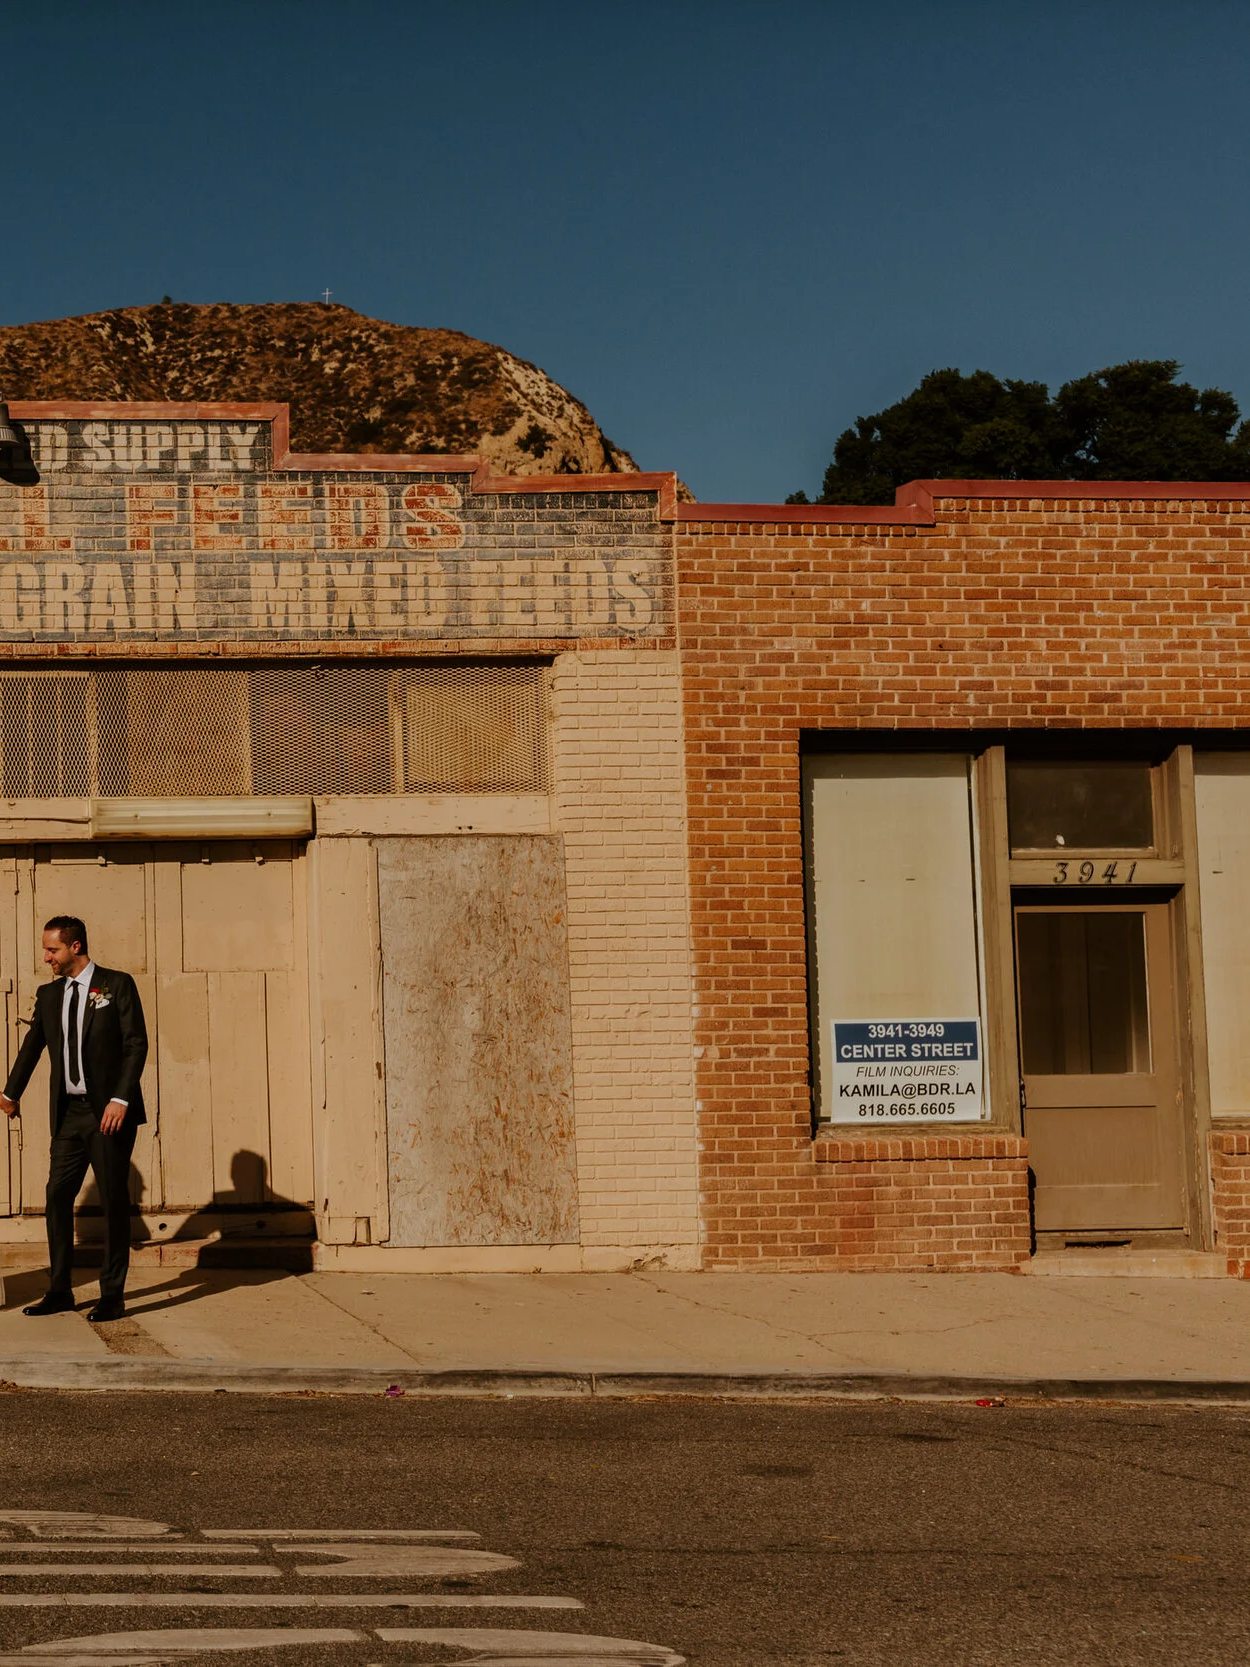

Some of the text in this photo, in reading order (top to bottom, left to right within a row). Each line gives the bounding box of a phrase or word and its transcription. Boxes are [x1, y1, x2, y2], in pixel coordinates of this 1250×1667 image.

[82, 421, 262, 470] SUPPLY
[124, 482, 466, 551] FEEDS
[1, 560, 197, 632] GRAIN
[249, 560, 447, 631] MIXED
[1052, 860, 1139, 884] 3941
[868, 1023, 945, 1039] 3941-3949
[840, 1042, 973, 1058] CENTER STREET
[856, 1065, 960, 1078] FILM INQUIRIES:
[839, 1082, 976, 1099] KAMILA@BDR.LA
[858, 1102, 956, 1117] 818.665.6605
